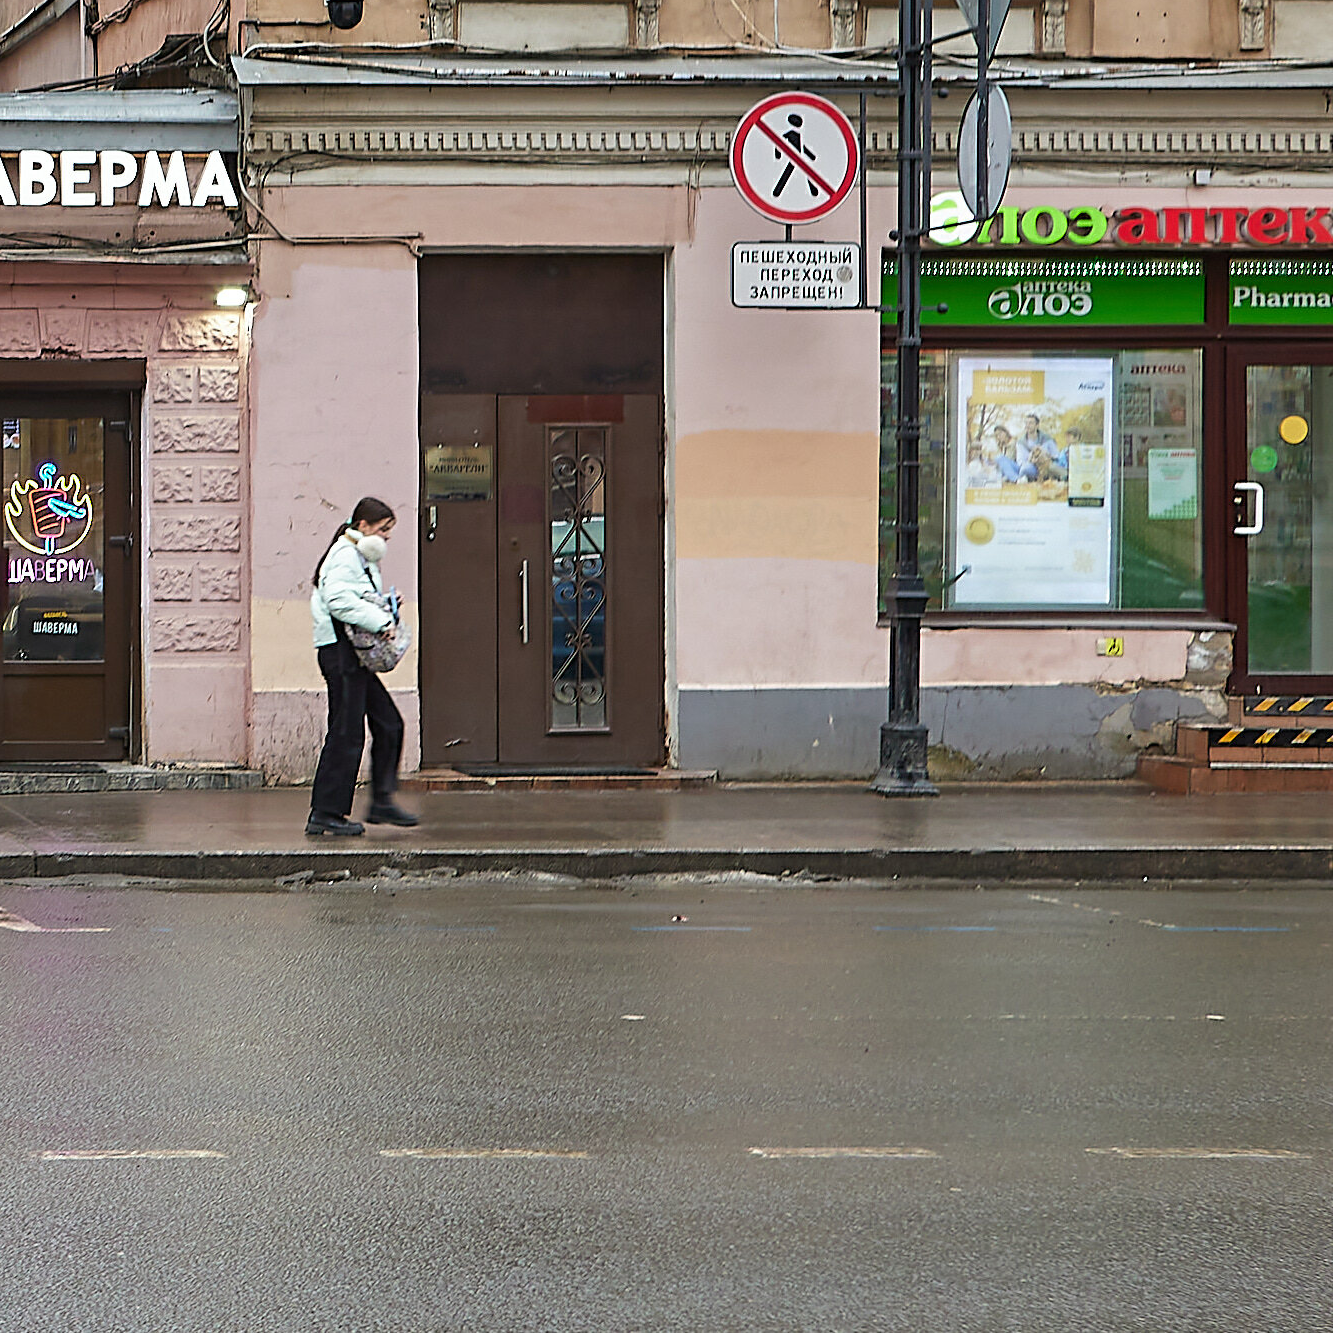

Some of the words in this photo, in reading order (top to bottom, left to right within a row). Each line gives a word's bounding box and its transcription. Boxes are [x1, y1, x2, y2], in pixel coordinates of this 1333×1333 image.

[1118, 206, 1333, 245] аптек
[740, 247, 852, 266] ПЕШЕХОДНЫЙ
[760, 268, 834, 283] ПЕРЕХОД
[750, 286, 843, 301] ЗАПРЕЩЕН!
[1023, 281, 1092, 294] аптека
[1233, 286, 1333, 307] Pharma
[8, 558, 96, 583] ШАВЕРМА
[33, 621, 79, 635] ШАВЕРМА
